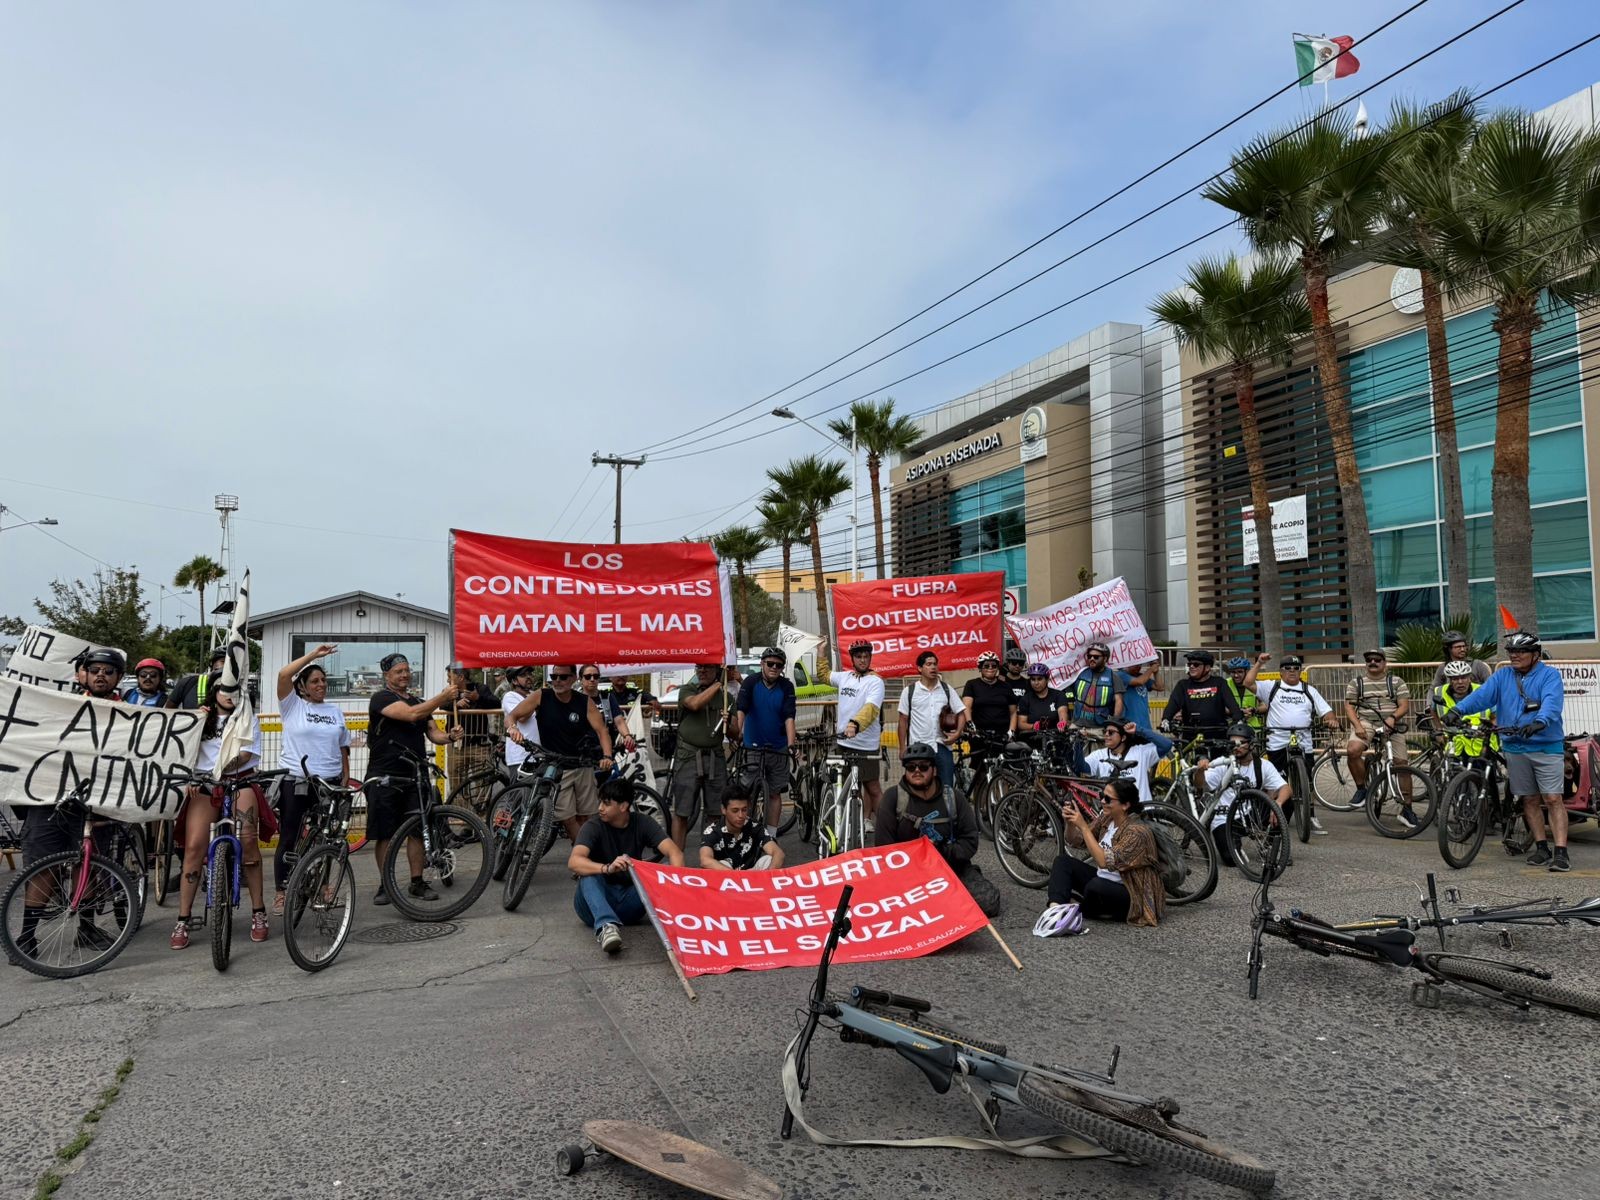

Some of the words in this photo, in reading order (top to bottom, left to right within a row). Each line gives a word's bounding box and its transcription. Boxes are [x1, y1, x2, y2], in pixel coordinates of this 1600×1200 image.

[905, 456, 944, 482] ASIPONA
[945, 432, 1001, 467] ENSENADA
[1279, 519, 1305, 529] ACOPIO
[563, 552, 624, 570] LOS
[464, 575, 712, 597] CONTENEDORES
[892, 581, 958, 598] FUERA
[479, 614, 585, 633] MATAN
[596, 613, 631, 632] EL
[640, 613, 703, 632] MAR
[842, 602, 999, 631] CONTENEDORES
[17, 628, 55, 662] NO
[479, 650, 560, 658] @ENSENADADIGNA
[618, 648, 708, 657] @SALVEMOS_ELSAUZAL
[871, 638, 912, 655] DEL
[917, 630, 988, 649] SAUZAL
[1556, 667, 1597, 680] TRADA
[58, 700, 199, 760] AMOR
[656, 870, 707, 888] NO
[719, 878, 764, 893] AL
[772, 850, 911, 891] PUERTO
[769, 895, 820, 913] DE
[676, 936, 729, 957] EN
[741, 939, 788, 956] EL
